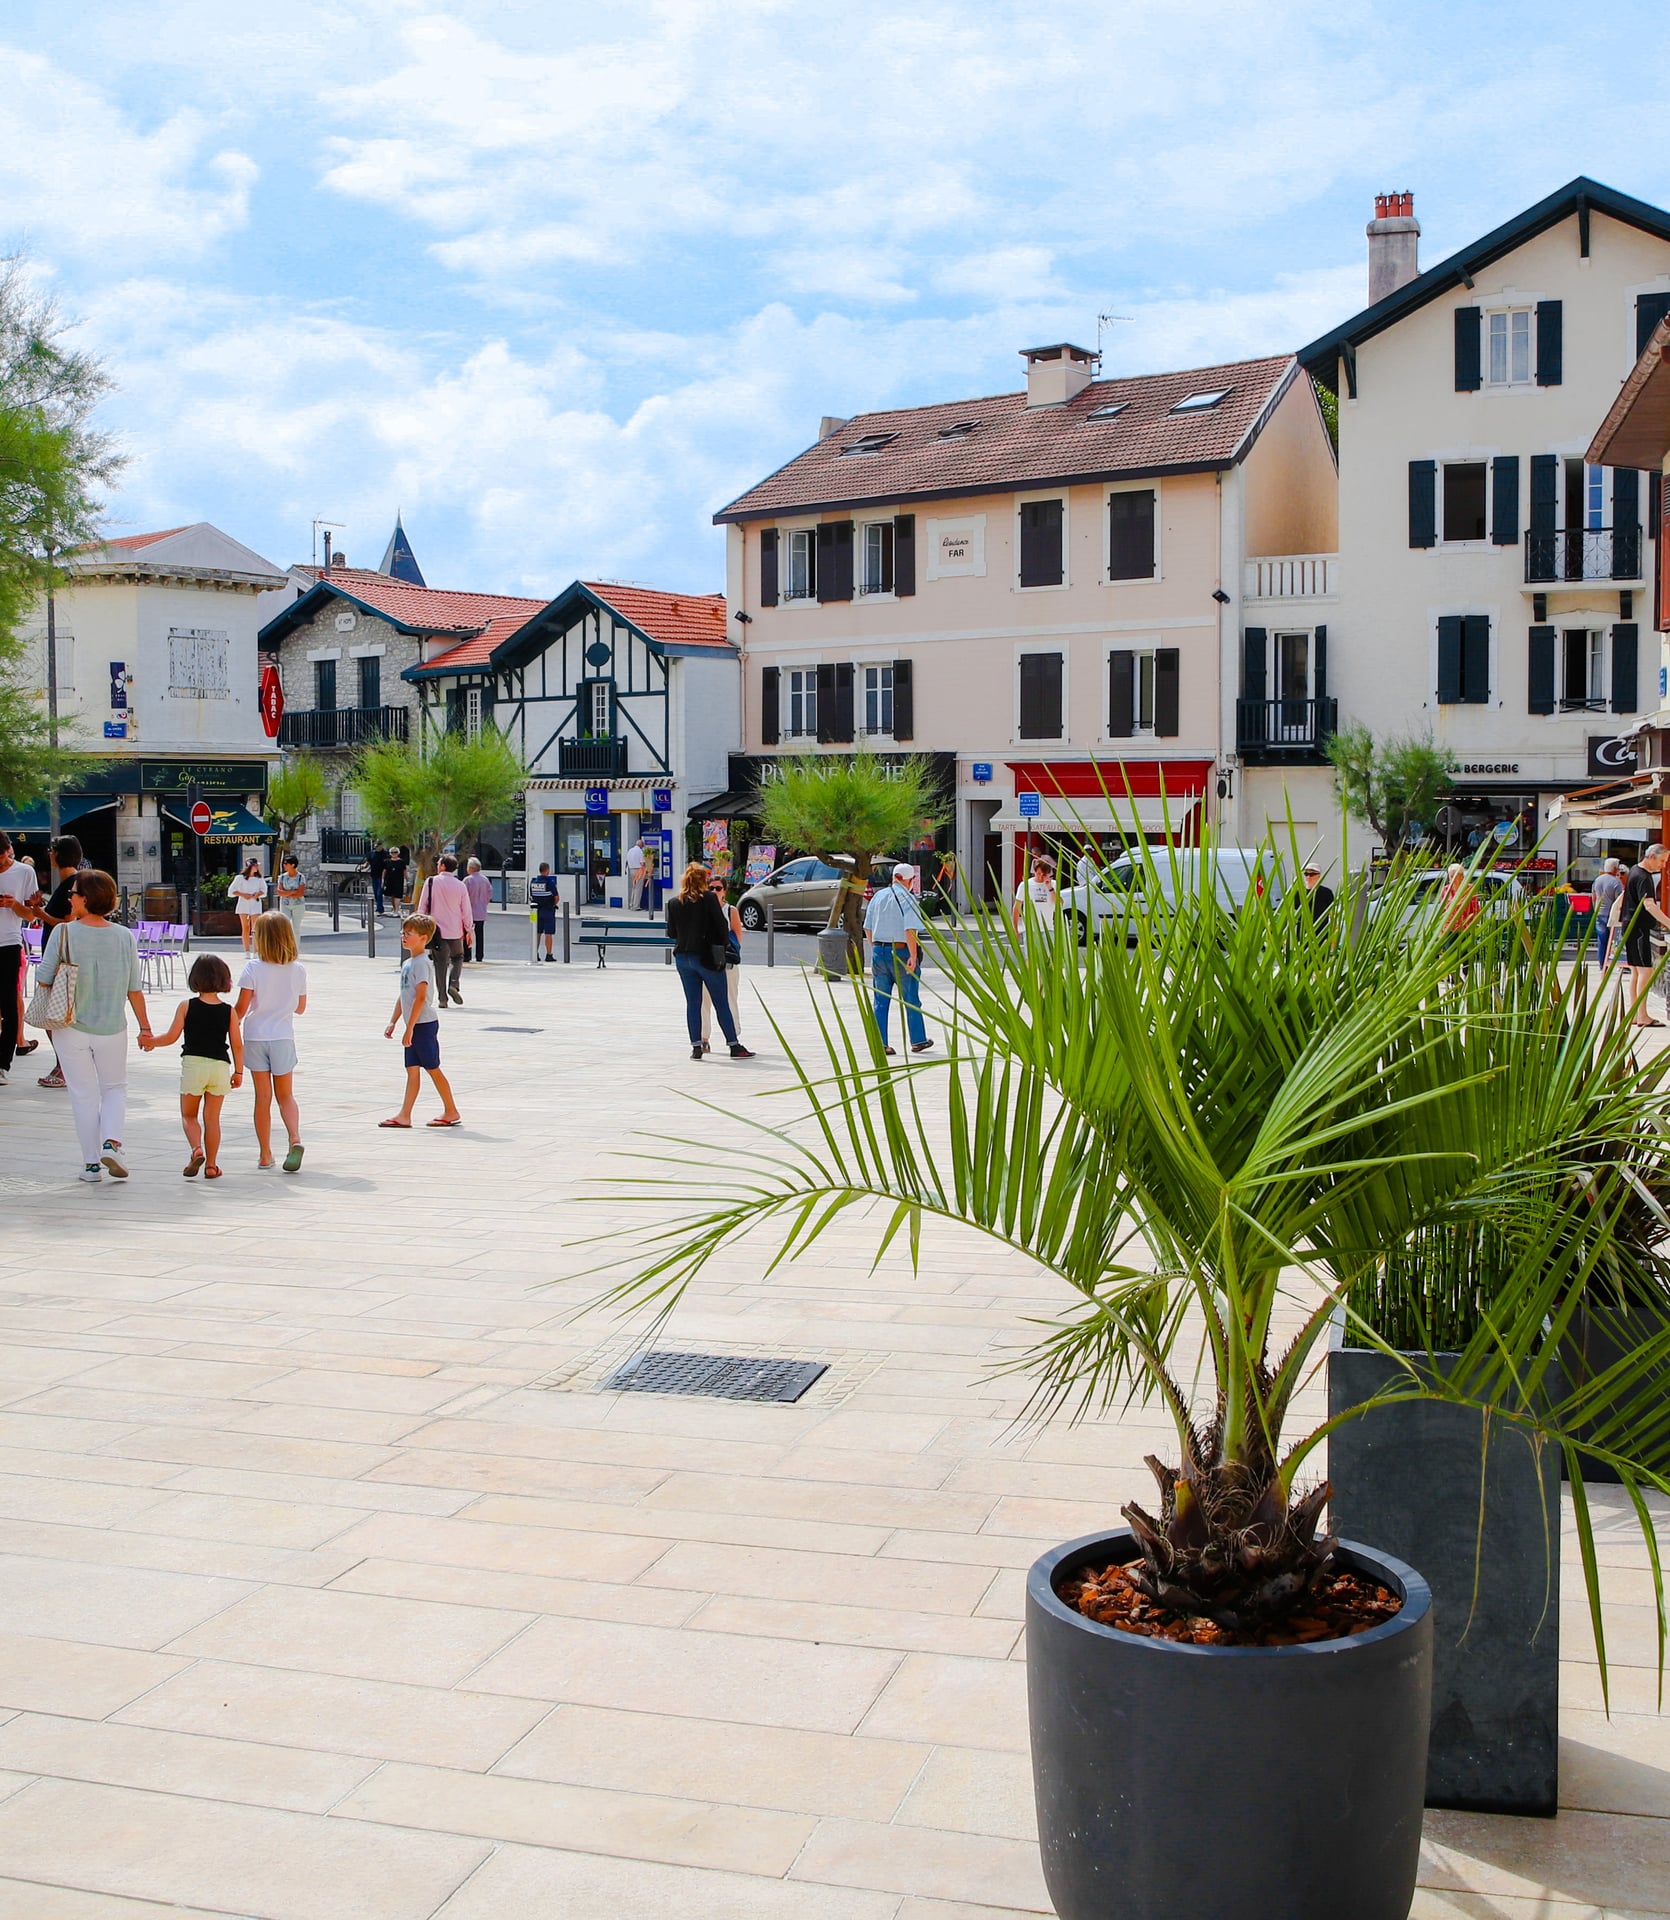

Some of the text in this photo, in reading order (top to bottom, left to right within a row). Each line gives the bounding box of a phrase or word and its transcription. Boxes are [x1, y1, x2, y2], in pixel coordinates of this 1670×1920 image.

[948, 548, 965, 557] FAR
[1464, 764, 1519, 774] BERGERIE
[585, 793, 605, 802] LCL
[655, 794, 670, 802] LCL
[203, 836, 261, 845] RESTAURANT
